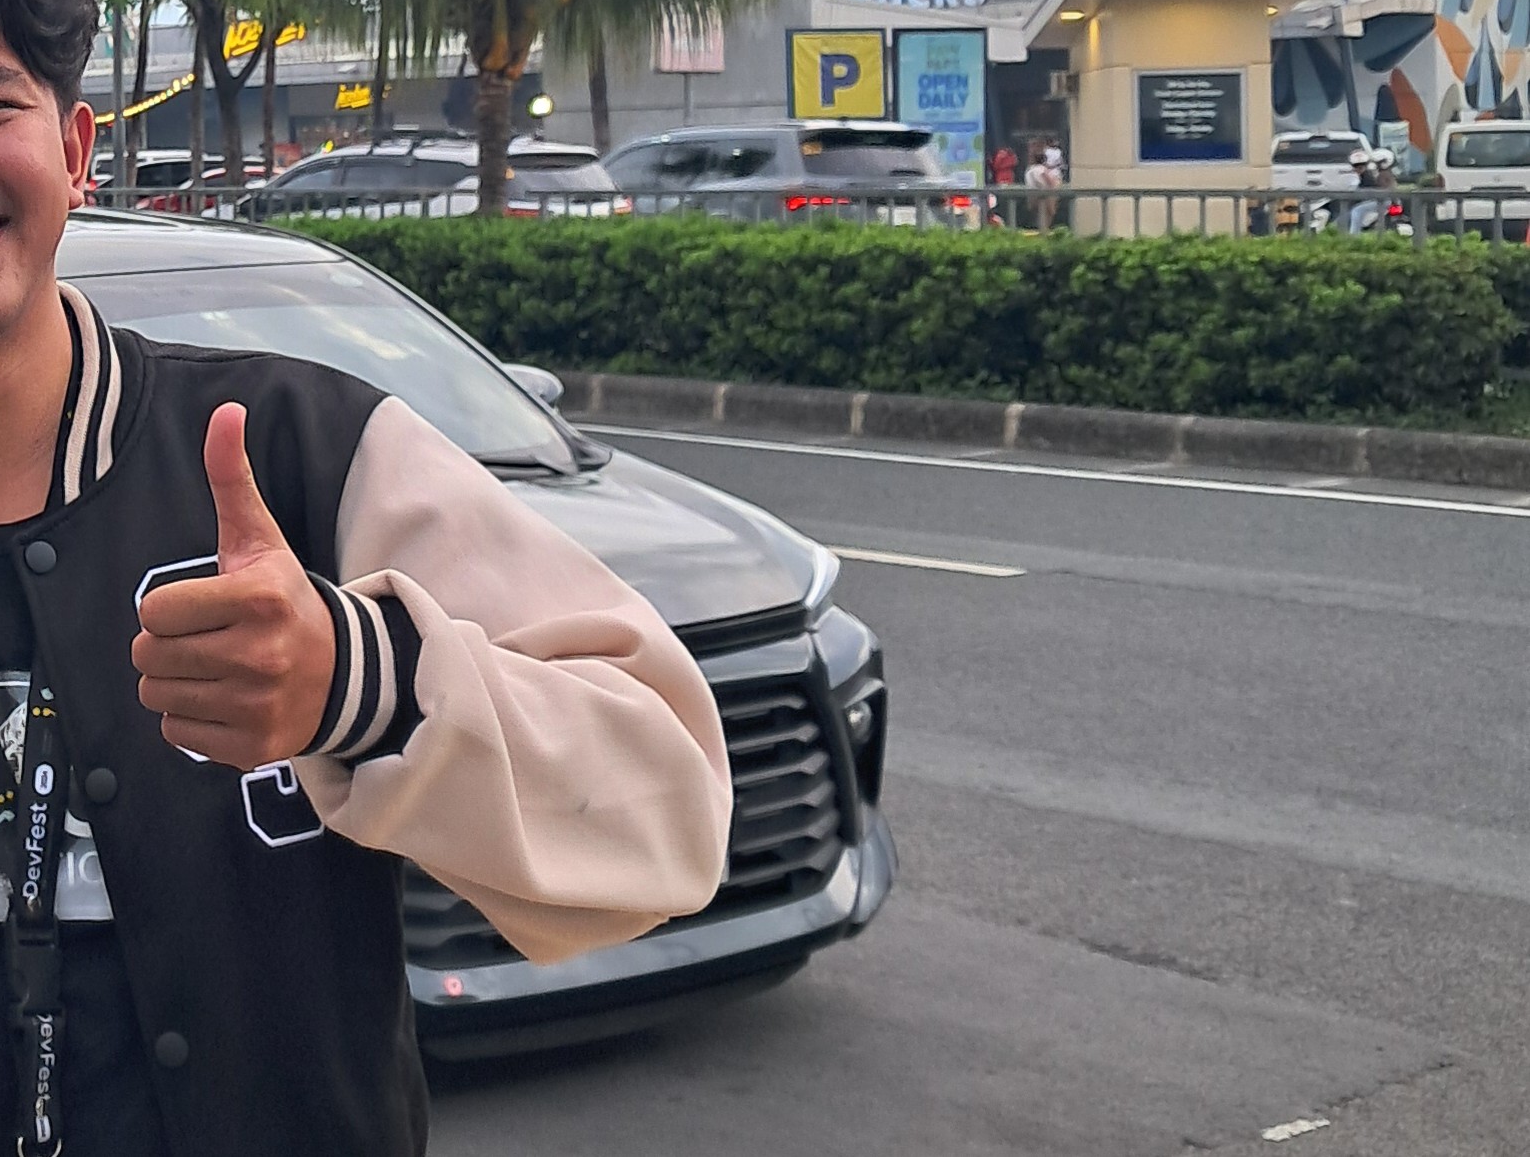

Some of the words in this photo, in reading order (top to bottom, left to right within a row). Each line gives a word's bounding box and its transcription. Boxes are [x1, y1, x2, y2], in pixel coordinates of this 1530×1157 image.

[821, 54, 861, 107] P
[918, 74, 968, 90] OPEN
[918, 92, 969, 108] DAILY
[22, 802, 48, 899] DevFest
